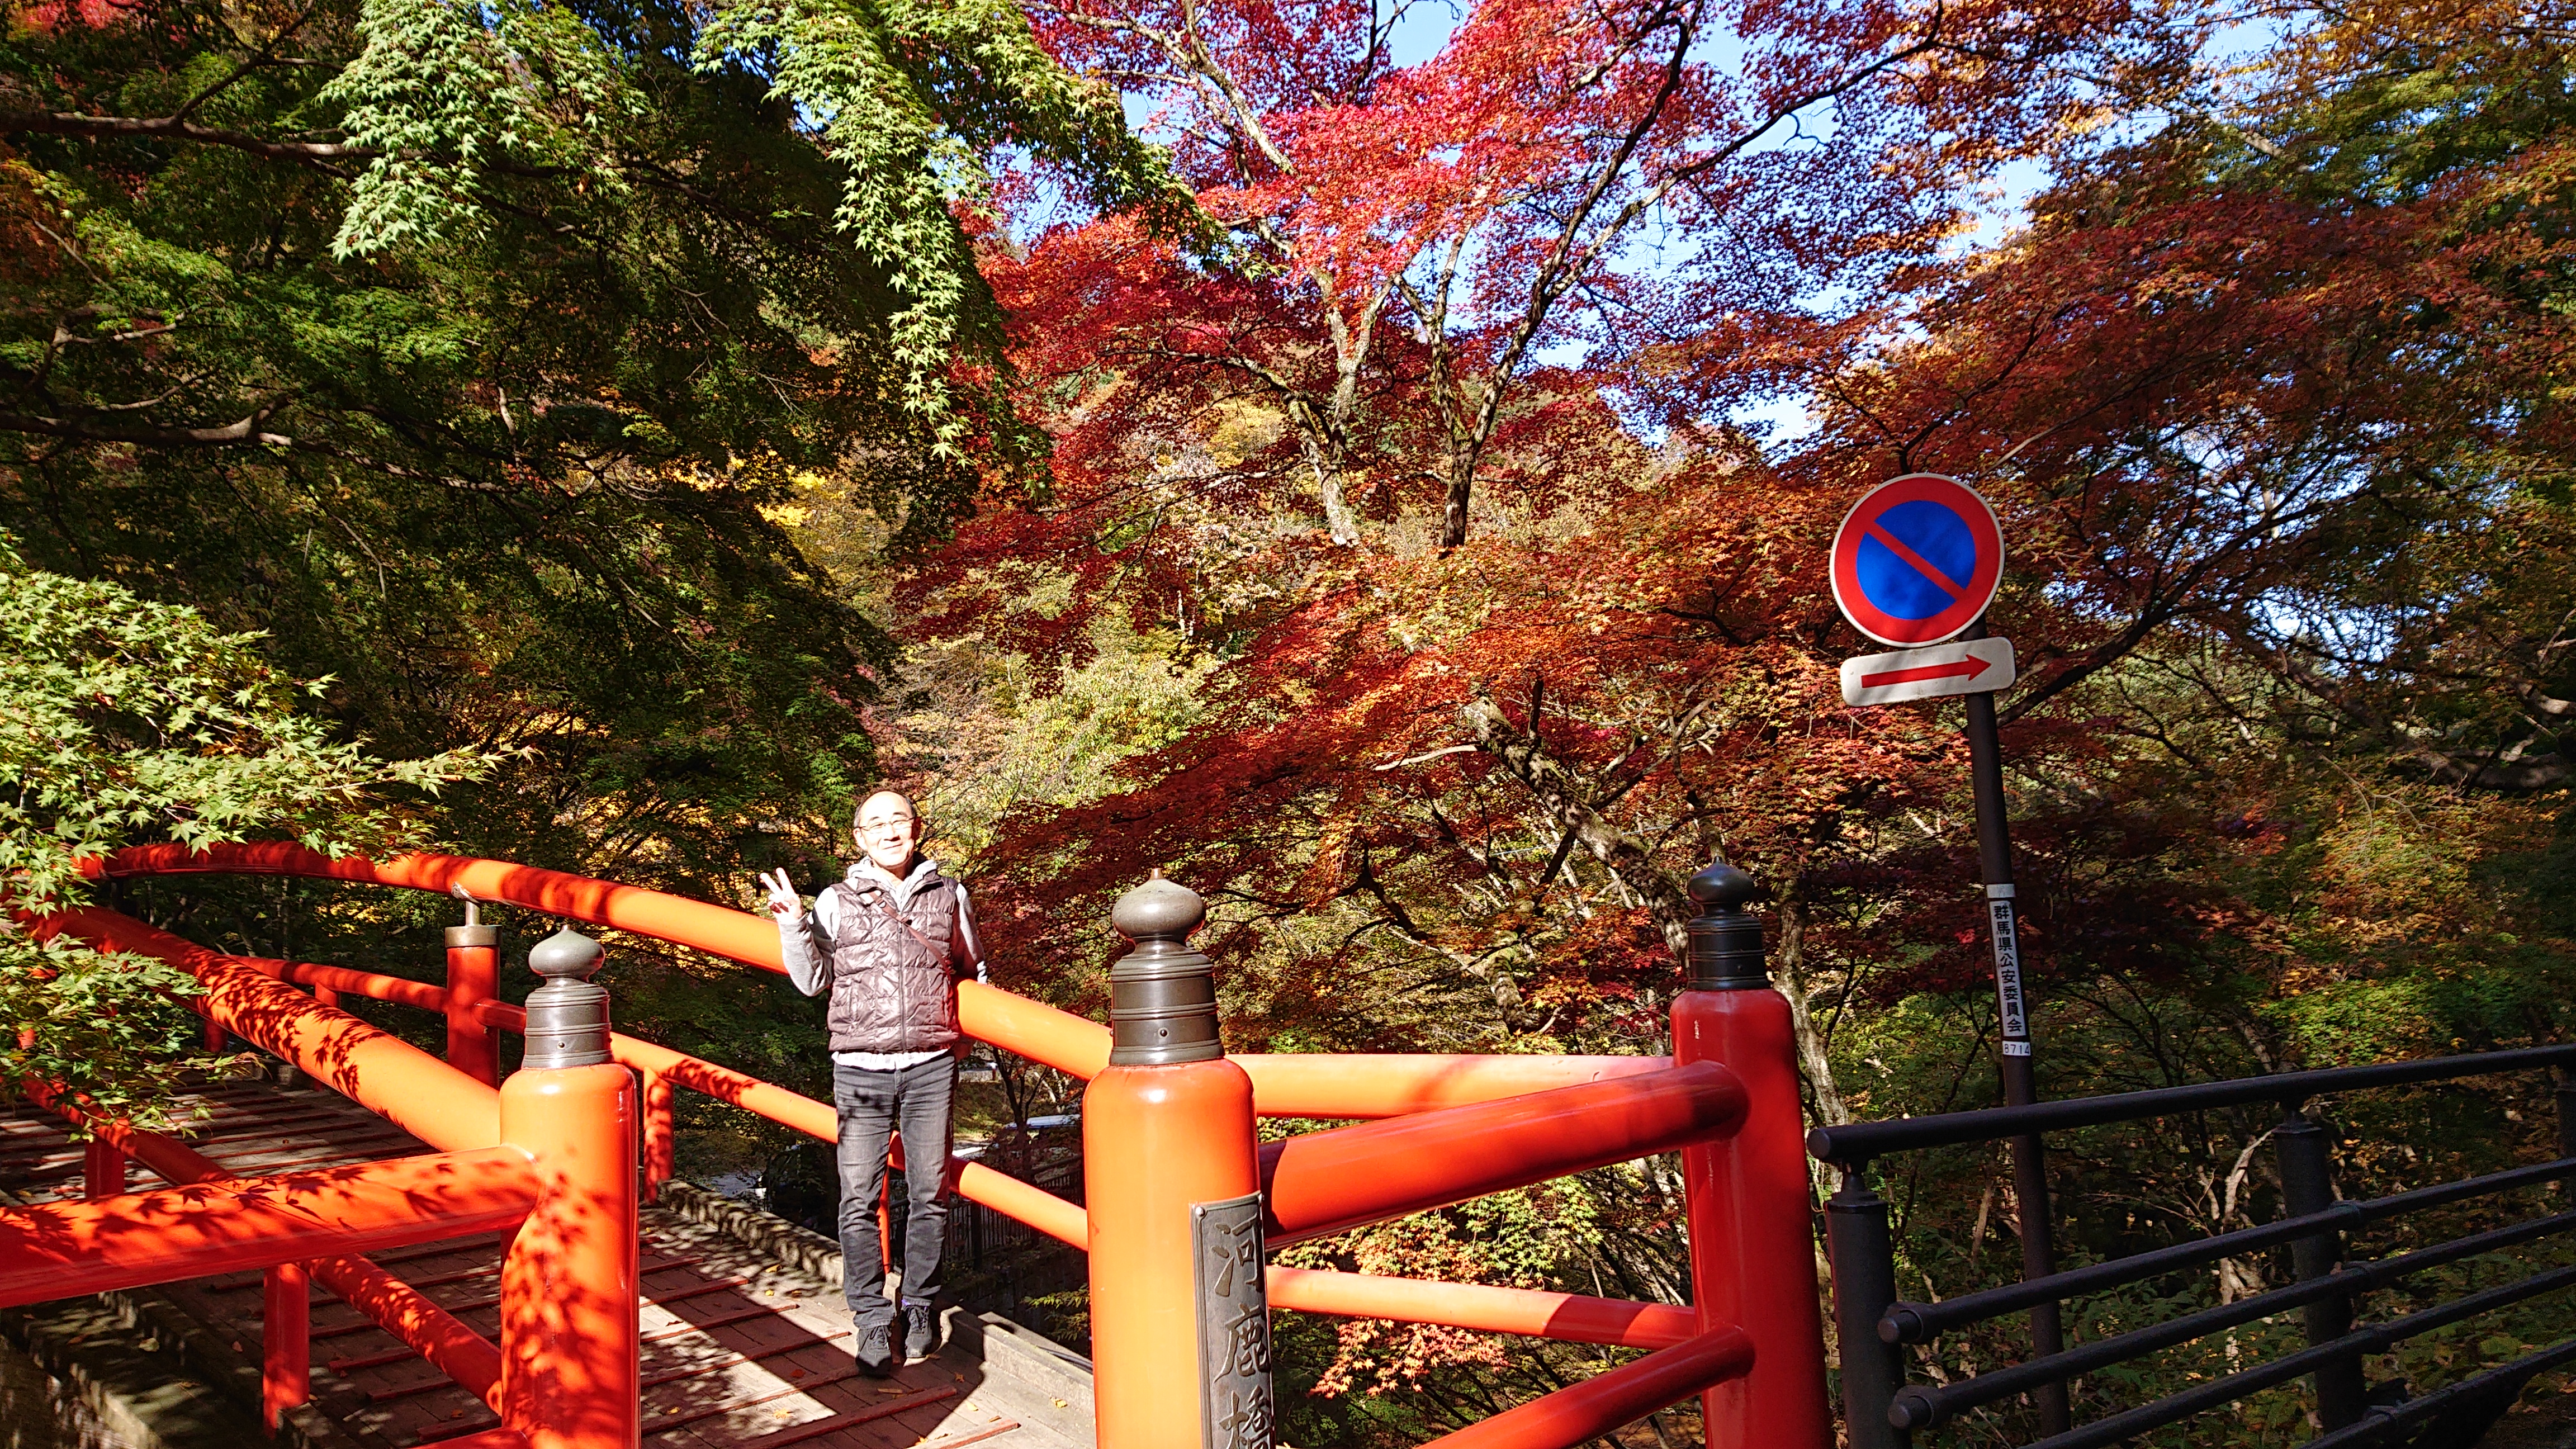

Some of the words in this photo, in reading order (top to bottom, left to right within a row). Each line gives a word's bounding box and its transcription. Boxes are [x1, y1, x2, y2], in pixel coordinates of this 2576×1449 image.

[1993, 905, 2022, 1033] 群馬県公安委員会
[2004, 1043, 2030, 1054] 8714
